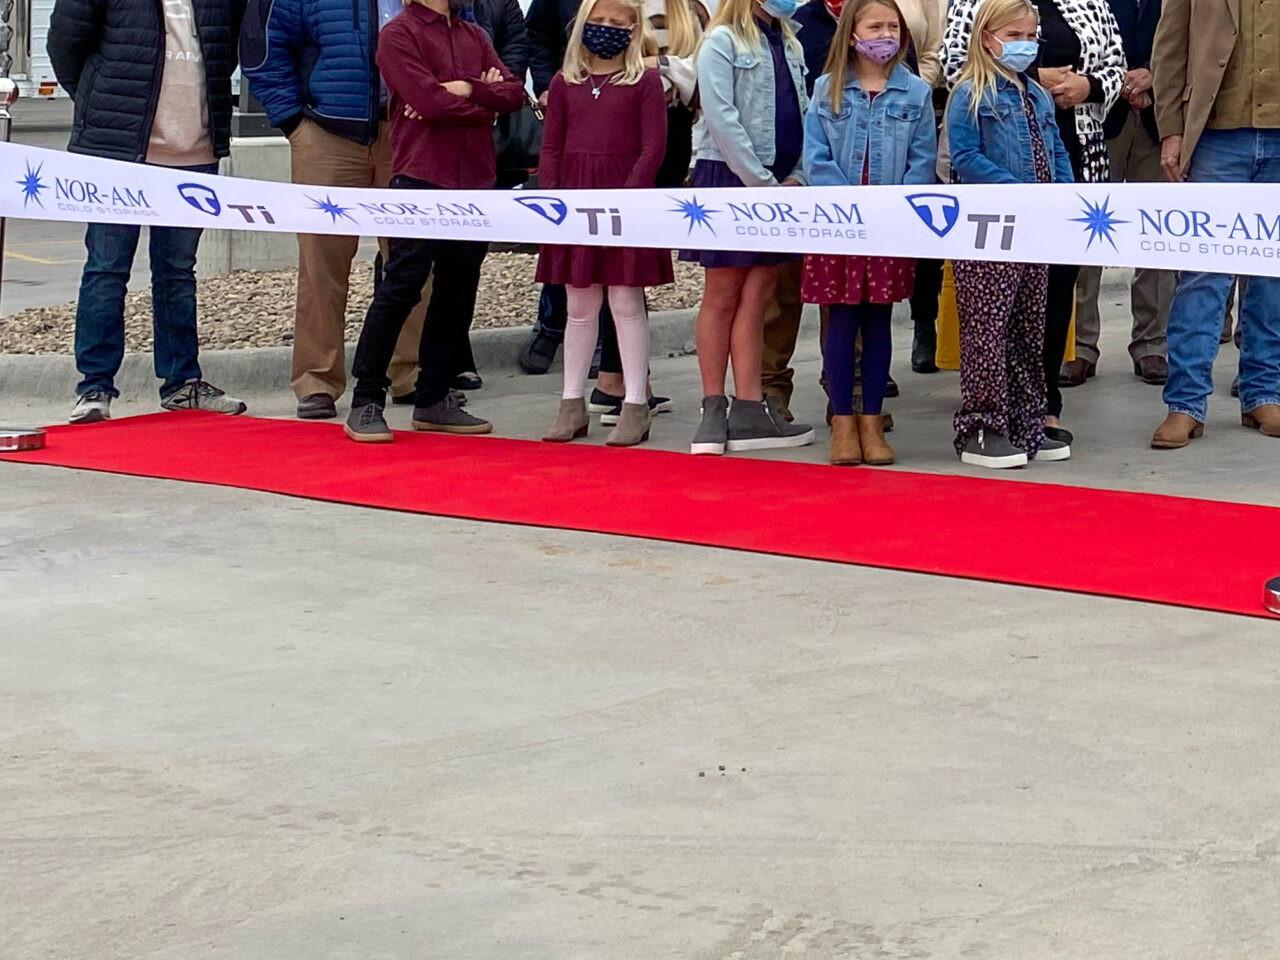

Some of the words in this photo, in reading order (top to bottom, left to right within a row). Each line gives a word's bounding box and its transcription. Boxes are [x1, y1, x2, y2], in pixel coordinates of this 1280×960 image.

[55, 177, 151, 208] NOR-AM
[57, 202, 93, 214] COLD
[96, 206, 160, 217] STORAGE
[227, 204, 275, 225] Ti
[358, 202, 488, 217] NOR-AM
[725, 202, 866, 225] NOR-AM
[373, 216, 414, 226] COLD
[420, 217, 493, 229] STORAGE
[575, 207, 622, 237] Ti
[735, 225, 780, 237] COLD
[787, 227, 868, 240] STORAGE
[967, 213, 1016, 251] Ti
[1140, 240, 1191, 253] COLD
